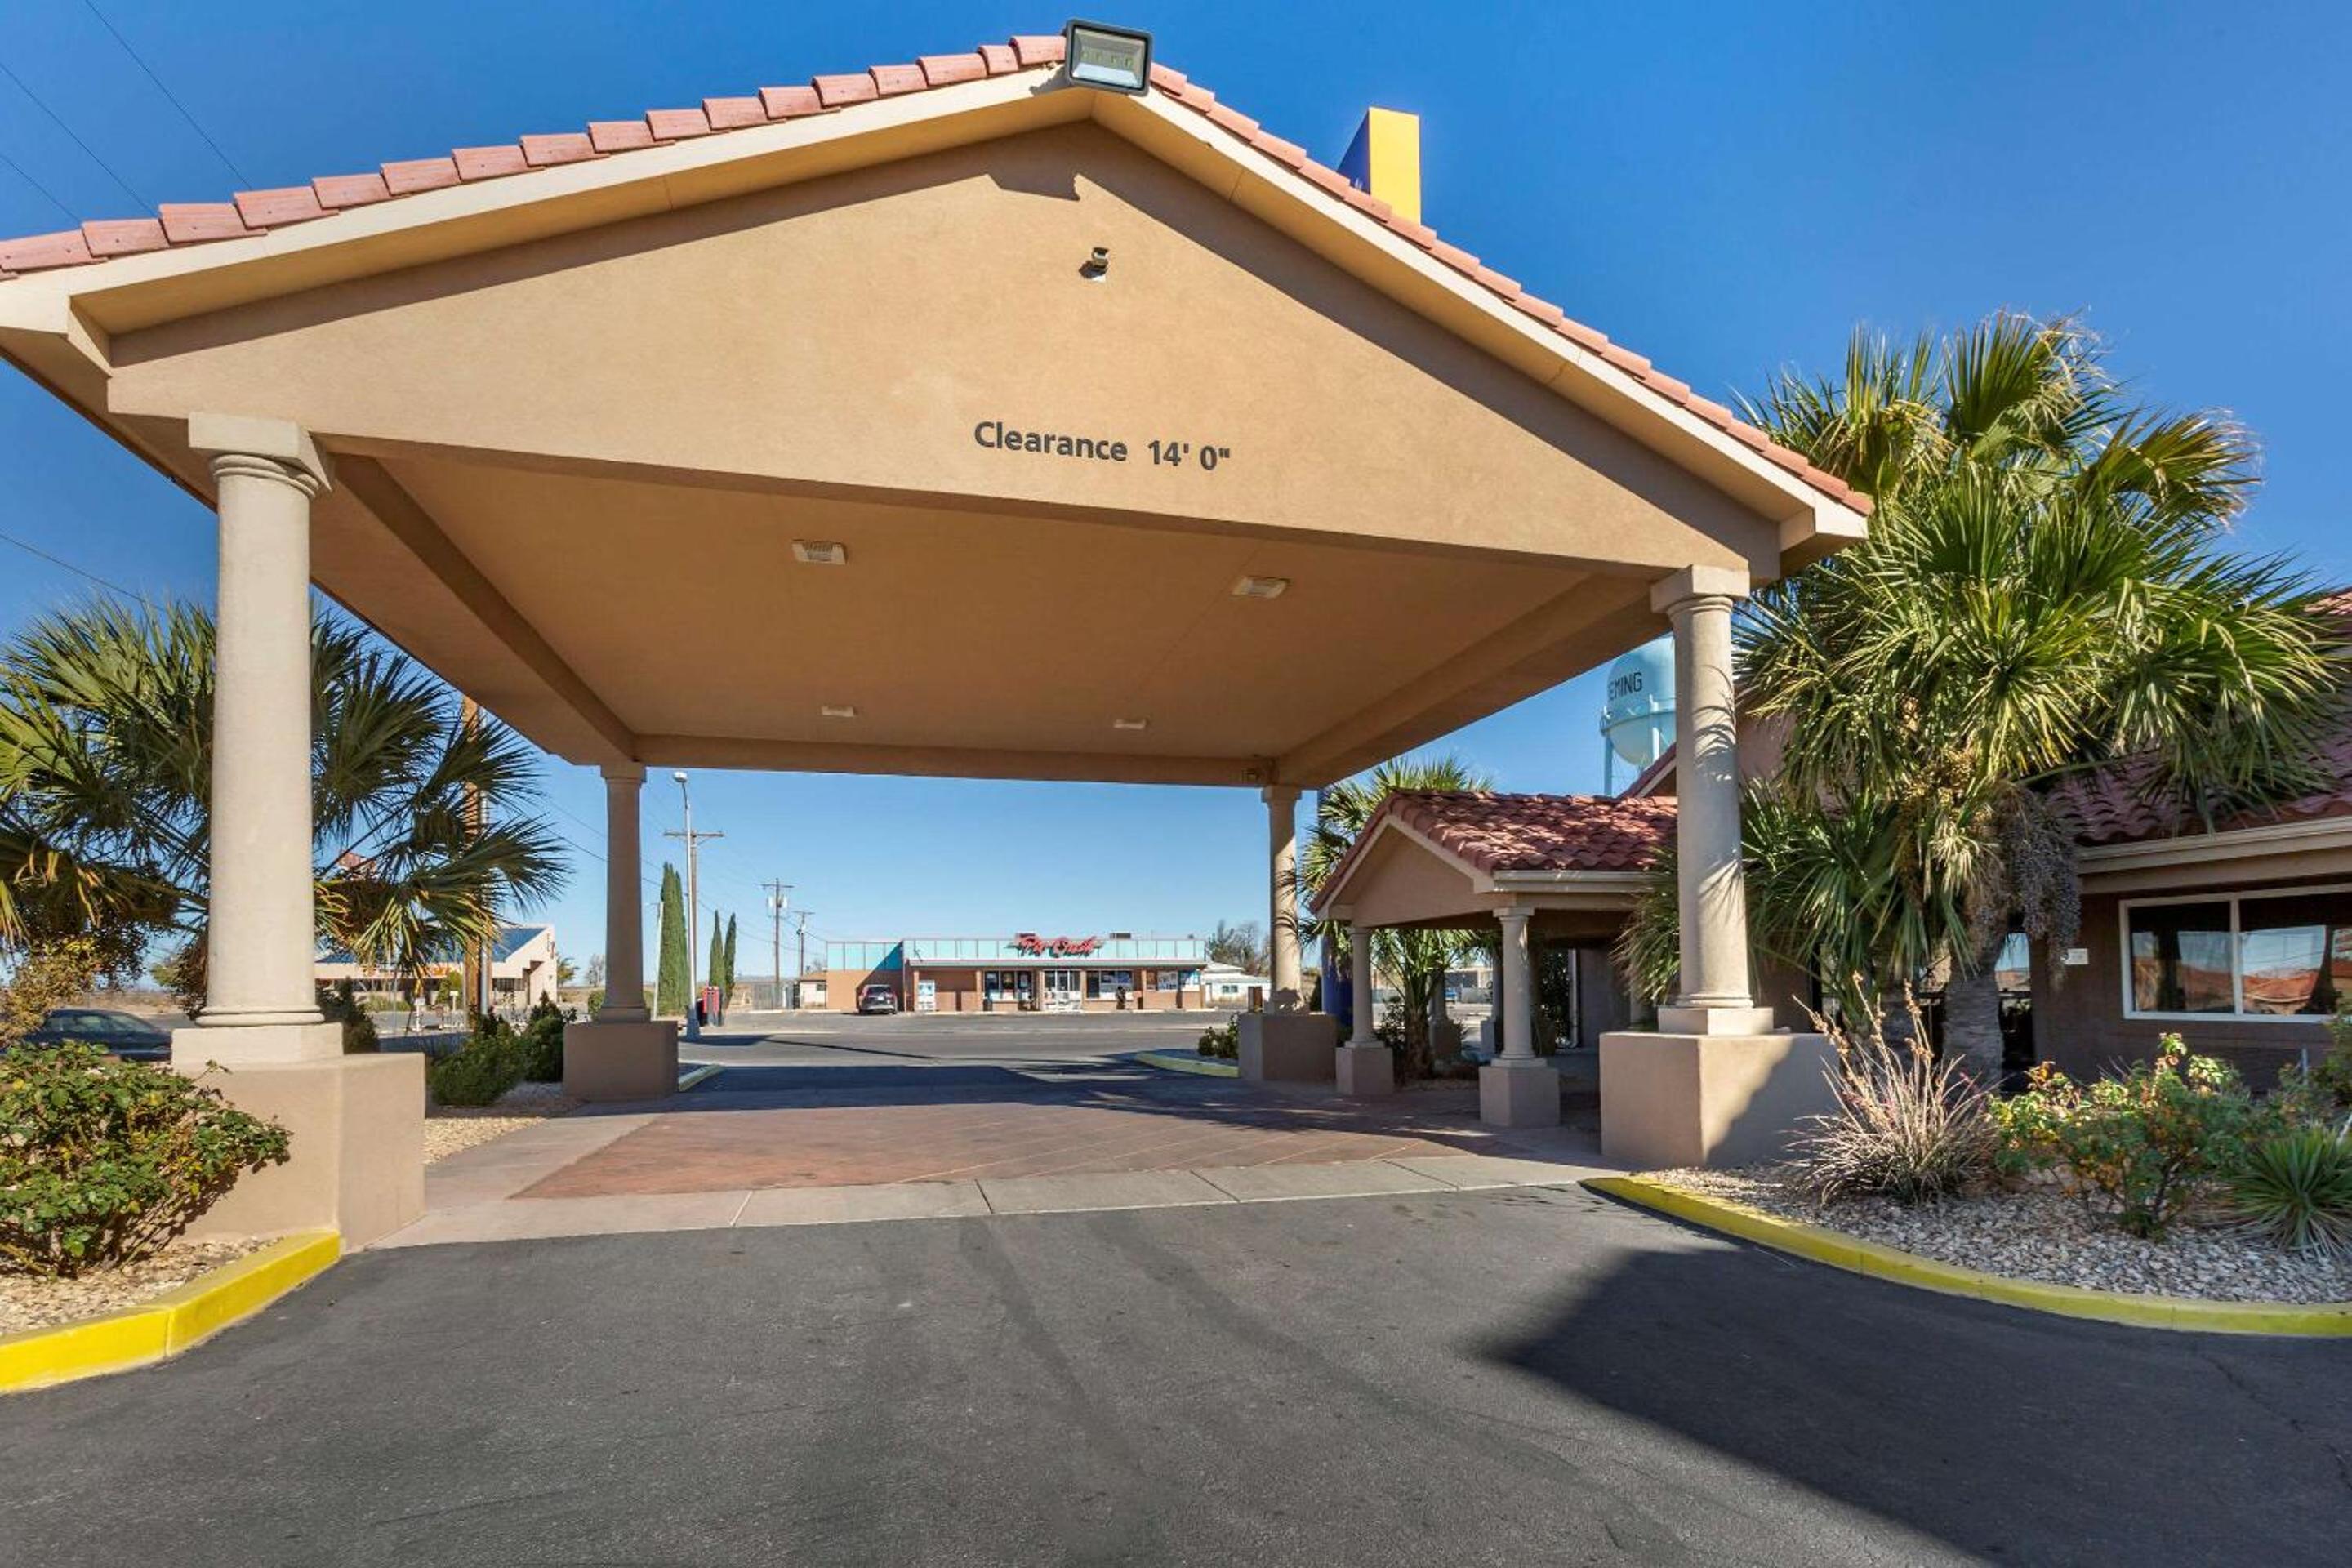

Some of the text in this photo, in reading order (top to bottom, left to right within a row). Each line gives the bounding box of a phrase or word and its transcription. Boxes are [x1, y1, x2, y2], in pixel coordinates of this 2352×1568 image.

[974, 421, 1230, 470] Clearance 14' 0"
